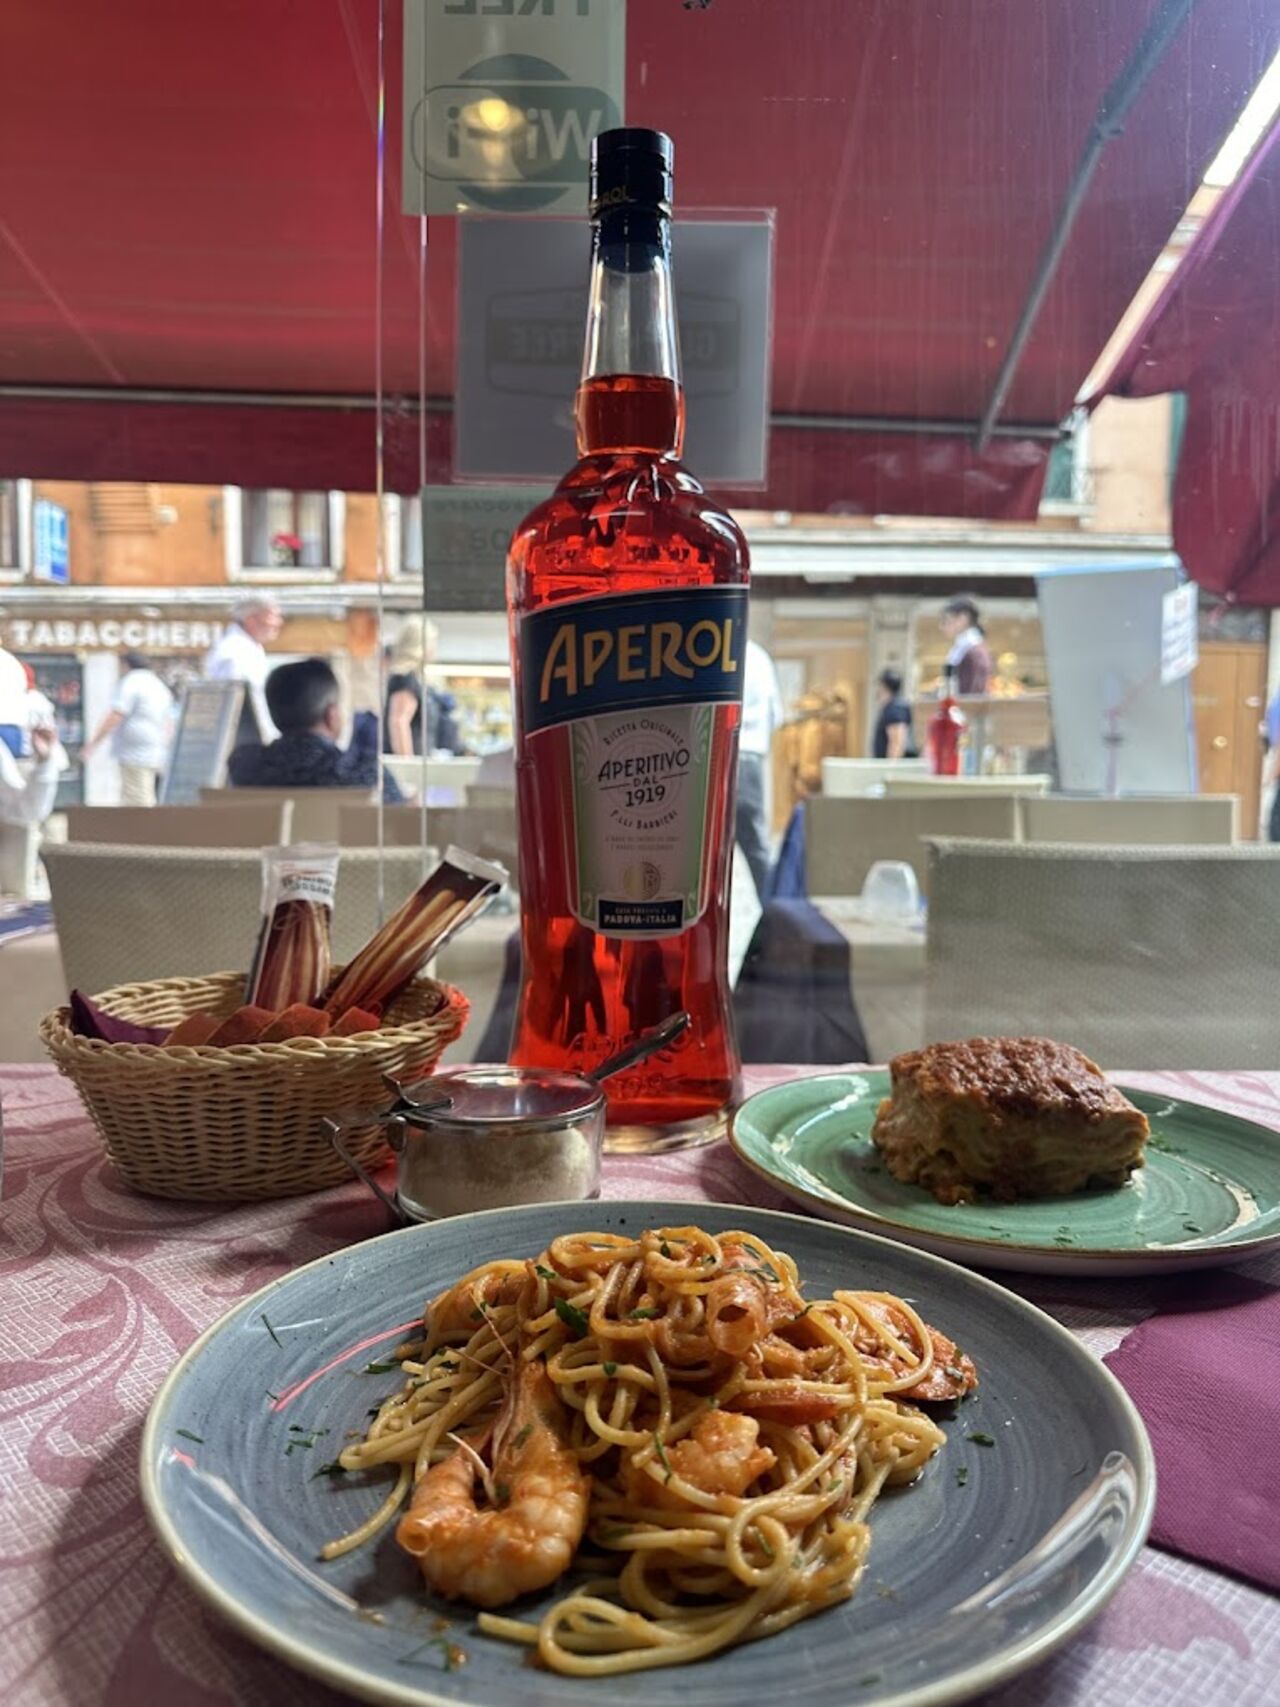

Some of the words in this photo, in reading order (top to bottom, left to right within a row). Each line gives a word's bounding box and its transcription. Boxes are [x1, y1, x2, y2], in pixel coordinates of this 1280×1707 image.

[540, 618, 737, 703] APEROL
[598, 748, 690, 783] APERITIVO
[625, 784, 666, 808] 1919
[633, 775, 659, 788] DAL
